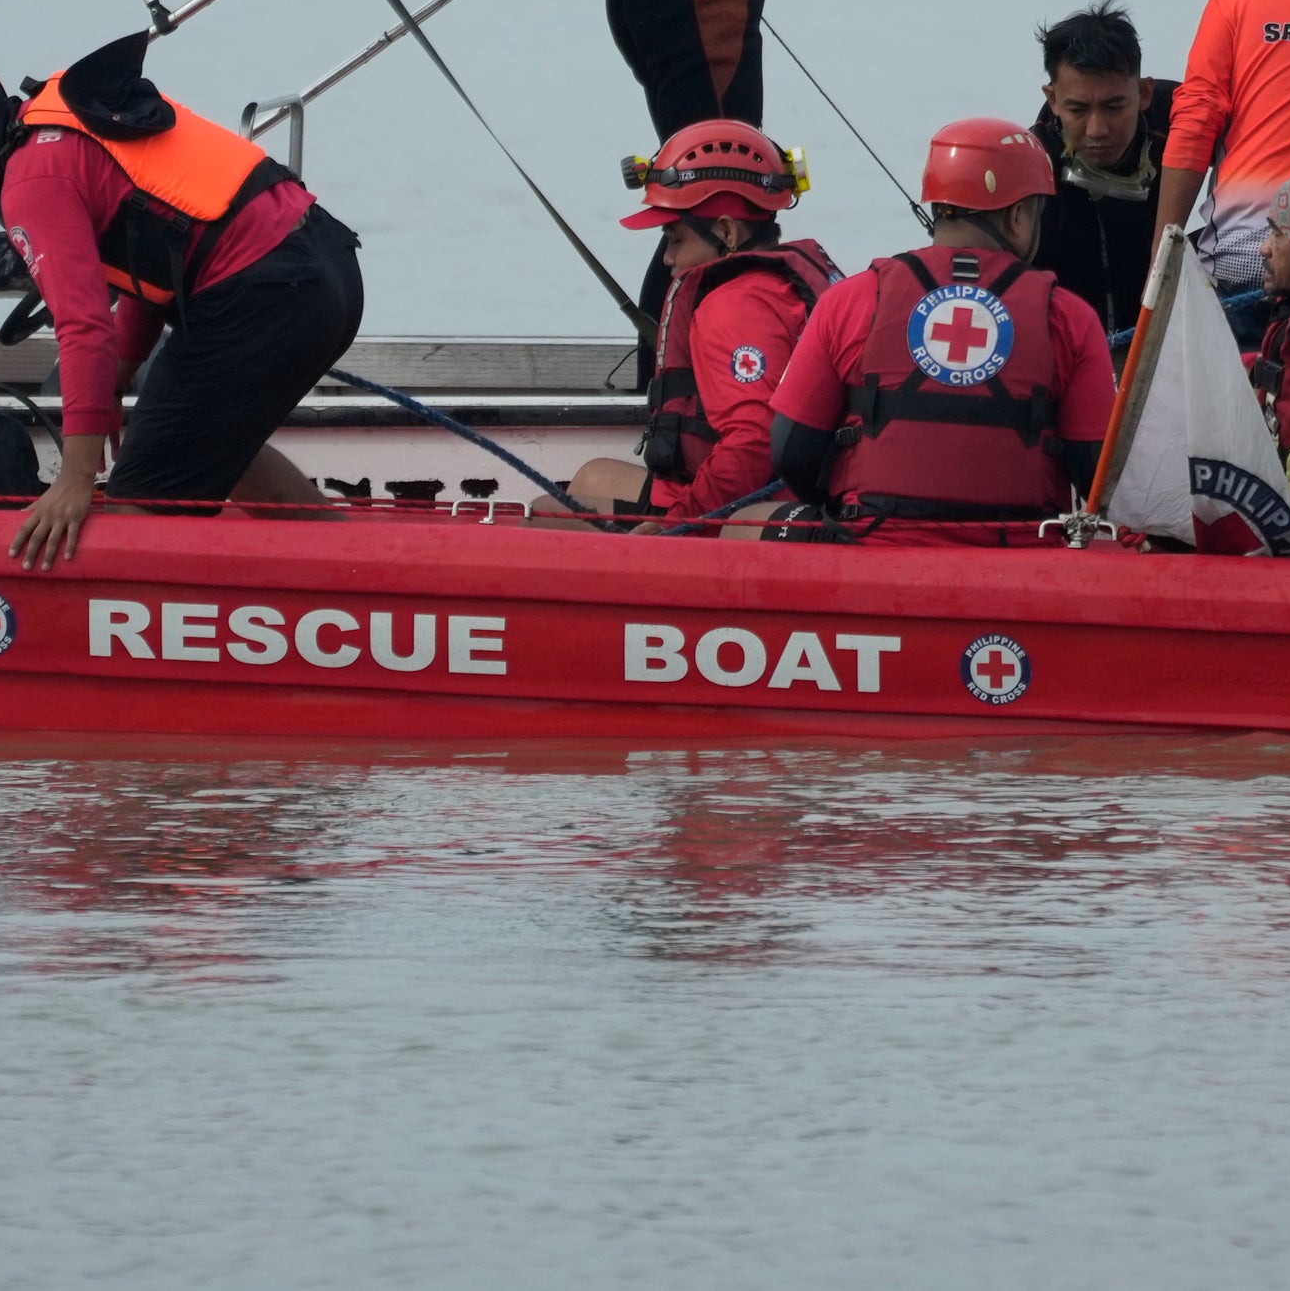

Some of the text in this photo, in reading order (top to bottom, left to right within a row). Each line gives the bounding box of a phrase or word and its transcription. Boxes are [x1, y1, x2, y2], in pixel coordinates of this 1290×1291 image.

[916, 285, 1009, 324] PHILIPPINE
[912, 346, 1004, 385] RED CROSS
[88, 598, 902, 694] RESCUE BOAT
[964, 635, 1026, 660] PHILIPPINE
[966, 681, 1027, 704] RED CROSS
